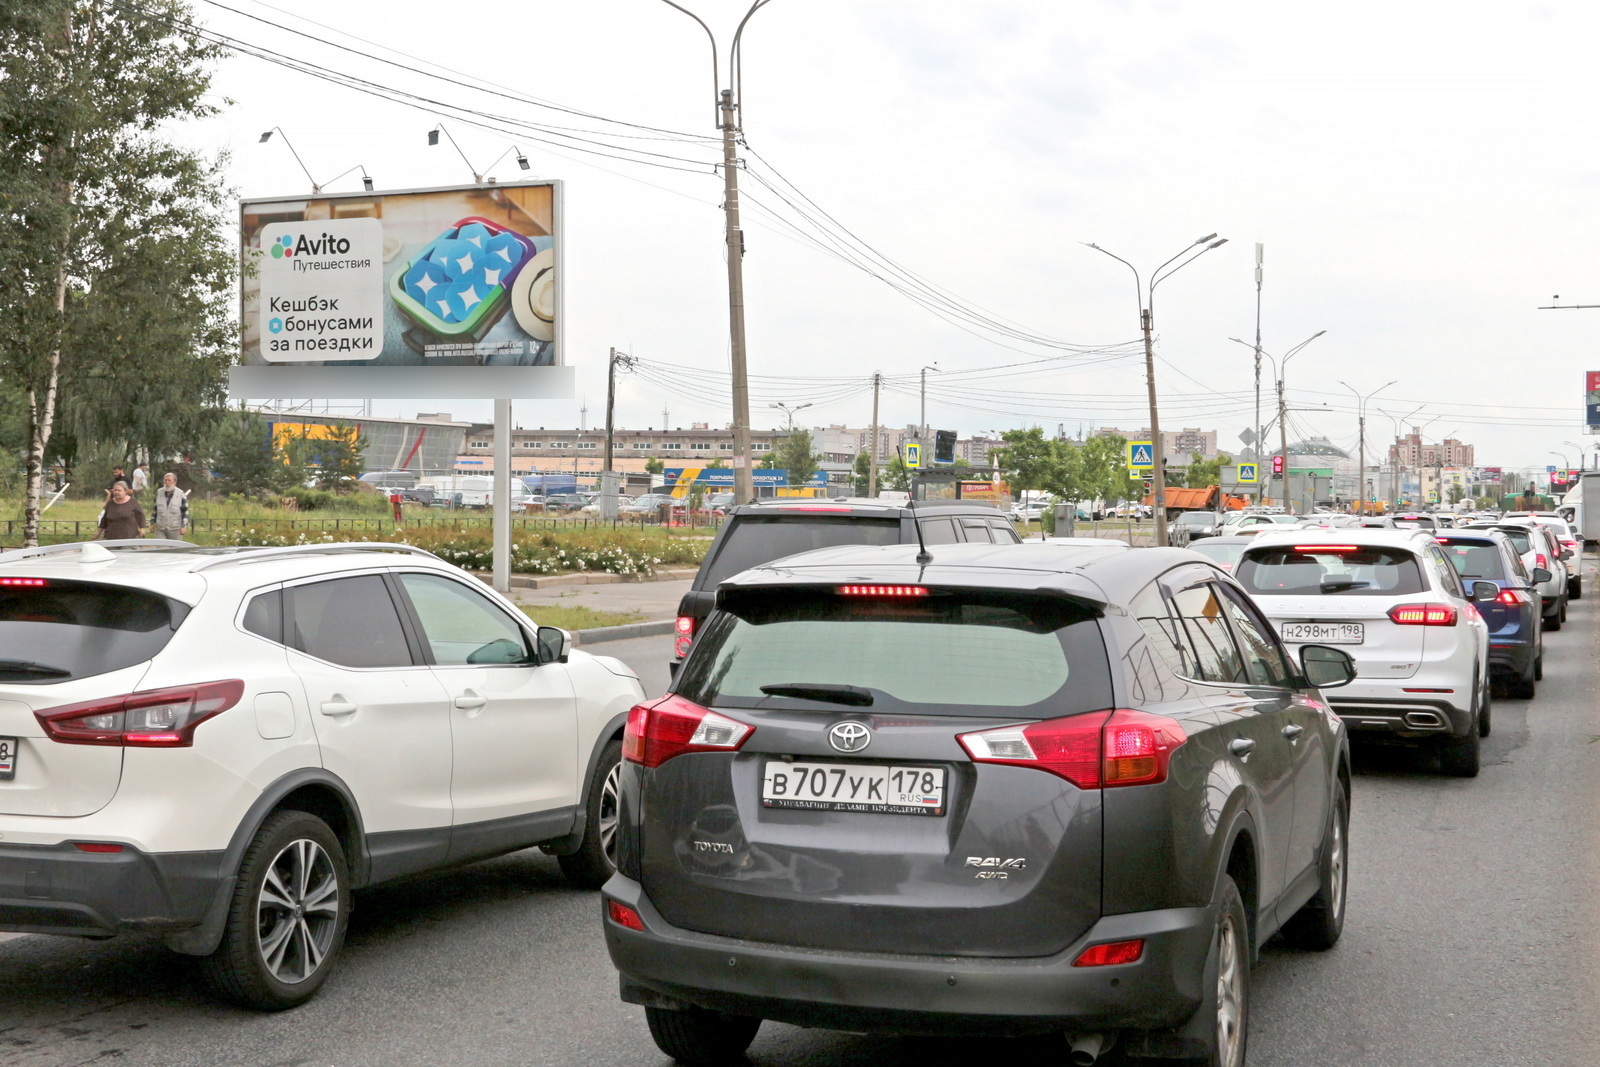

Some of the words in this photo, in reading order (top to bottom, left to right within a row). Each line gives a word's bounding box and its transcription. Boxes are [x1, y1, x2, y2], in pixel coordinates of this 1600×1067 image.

[294, 232, 350, 256] Avito
[293, 258, 371, 273] Путешествия
[270, 295, 339, 313] Кешбэк
[285, 315, 373, 338] бонусами
[269, 338, 290, 353] за
[295, 336, 373, 353] поездки
[529, 340, 540, 354] 12+
[1286, 625, 1337, 638] Н298МТ
[1340, 624, 1360, 635] 198
[772, 767, 884, 800] В707УК
[891, 769, 935, 794] 178
[900, 793, 922, 803] RUS
[694, 840, 734, 854] TOYOTA
[964, 856, 1026, 871] RAV4
[974, 871, 1009, 880] AWD
